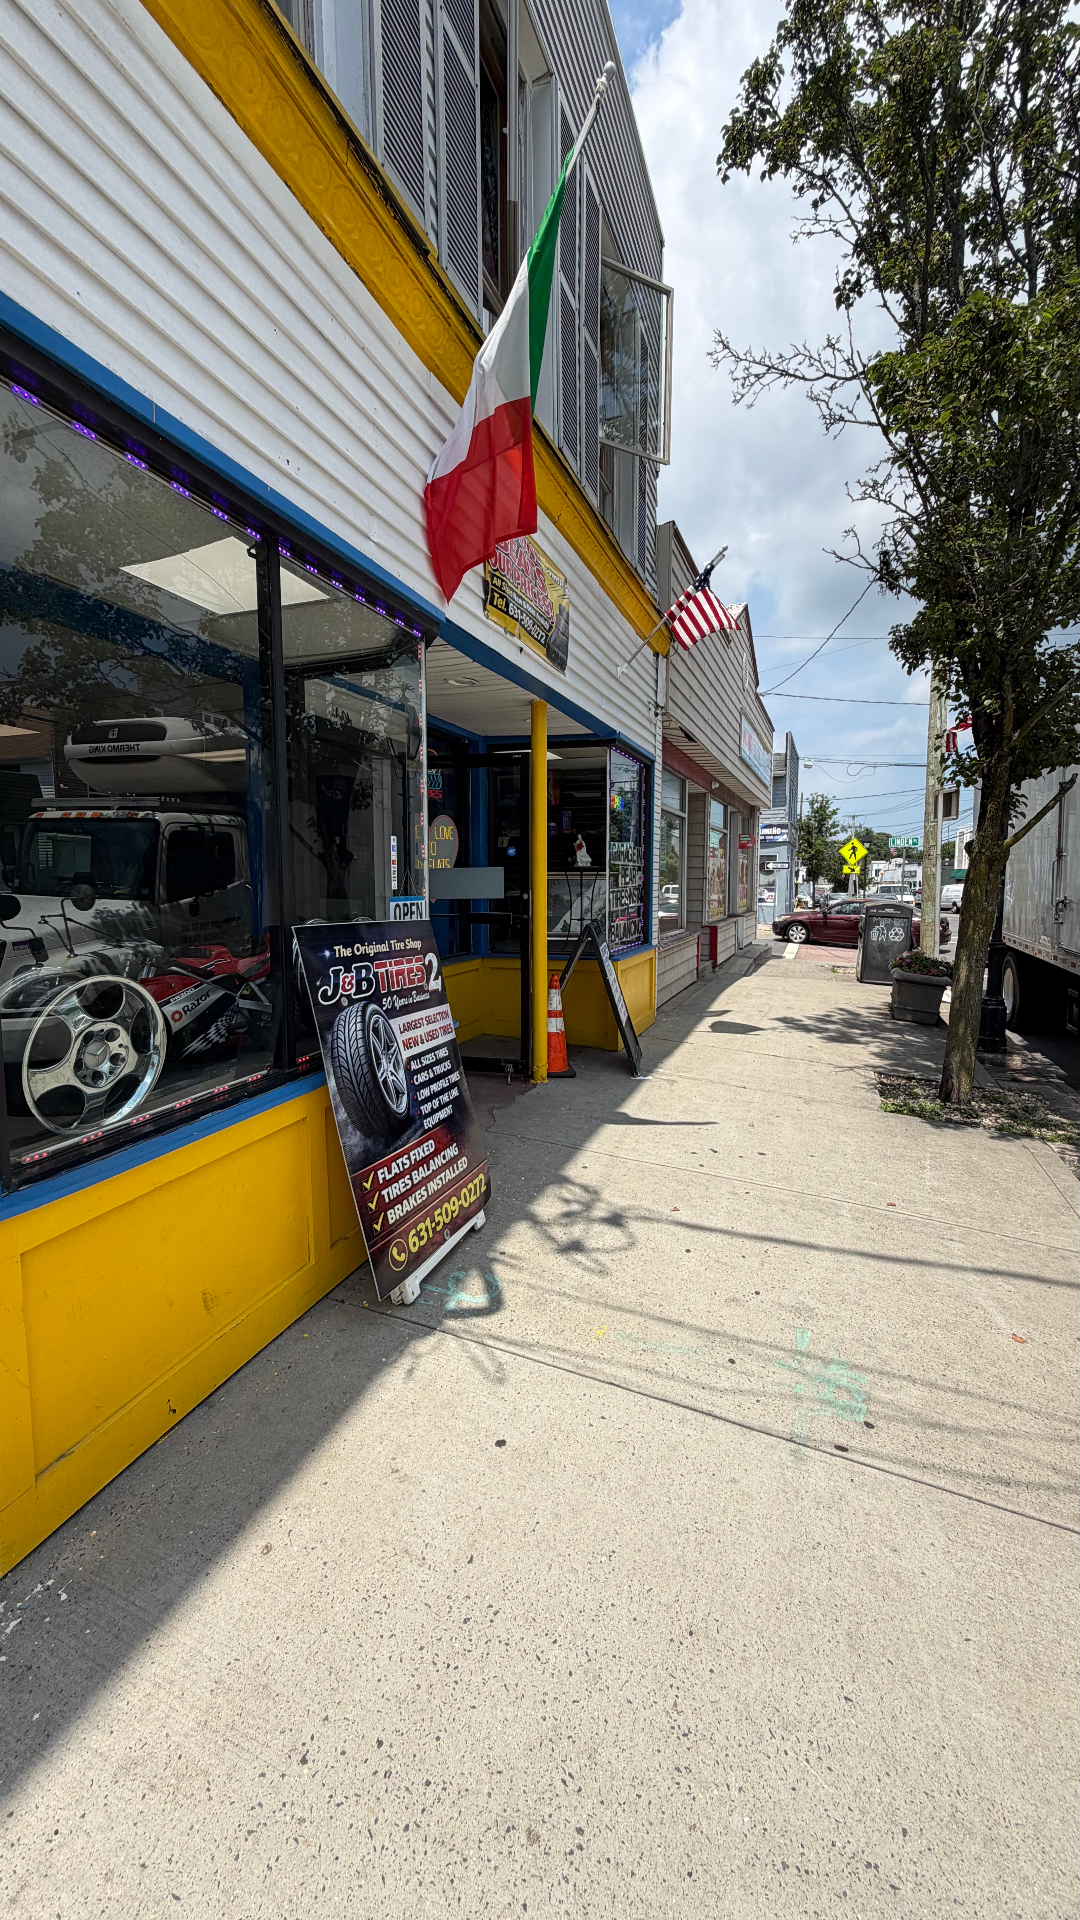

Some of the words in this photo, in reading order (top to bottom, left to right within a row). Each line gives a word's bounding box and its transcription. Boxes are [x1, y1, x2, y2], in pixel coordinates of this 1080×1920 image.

[493, 576, 502, 588] All
[493, 592, 507, 612] Tel.
[508, 602, 546, 644] 631-509-0272
[890, 838, 913, 847] LINDEN
[394, 902, 422, 920] OPEN
[333, 945, 352, 958] The
[354, 941, 390, 957] Original
[390, 939, 405, 951] Tire
[405, 938, 422, 951] Shop
[318, 962, 375, 1006] J&B
[373, 955, 426, 994] TIRES
[424, 952, 442, 993] 2
[182, 990, 211, 1015] Razor
[382, 996, 392, 1010] 50
[393, 995, 408, 1010] Years
[398, 1016, 424, 1034] LARGEST
[424, 1010, 450, 1027] SELECTION
[401, 1035, 418, 1052] NEW
[419, 1033, 424, 1045] &
[424, 1029, 439, 1043] USED
[438, 1022, 453, 1038] TIRES
[410, 1057, 421, 1070] ALL
[421, 1052, 435, 1067] SIZES
[435, 1046, 449, 1060] TIRES
[413, 1072, 428, 1086] CARS
[432, 1061, 452, 1076] TRUCKS
[416, 1087, 431, 1101] LOW
[430, 1077, 449, 1096] PROFILE
[448, 1071, 460, 1085] TIRES
[420, 1103, 432, 1116] TOP
[432, 1099, 439, 1110] OF
[439, 1094, 449, 1106] THE
[448, 1088, 460, 1101] LINE
[423, 1104, 453, 1130] EQUIPMENT
[377, 1156, 410, 1184] FLATS
[410, 1139, 435, 1165] FIXED
[381, 1177, 412, 1203] TIRES
[412, 1143, 458, 1180] BALANCING
[386, 1187, 427, 1225] BRAKES
[427, 1156, 468, 1198] INSTALLED
[408, 1173, 486, 1253] 631-509-0272
